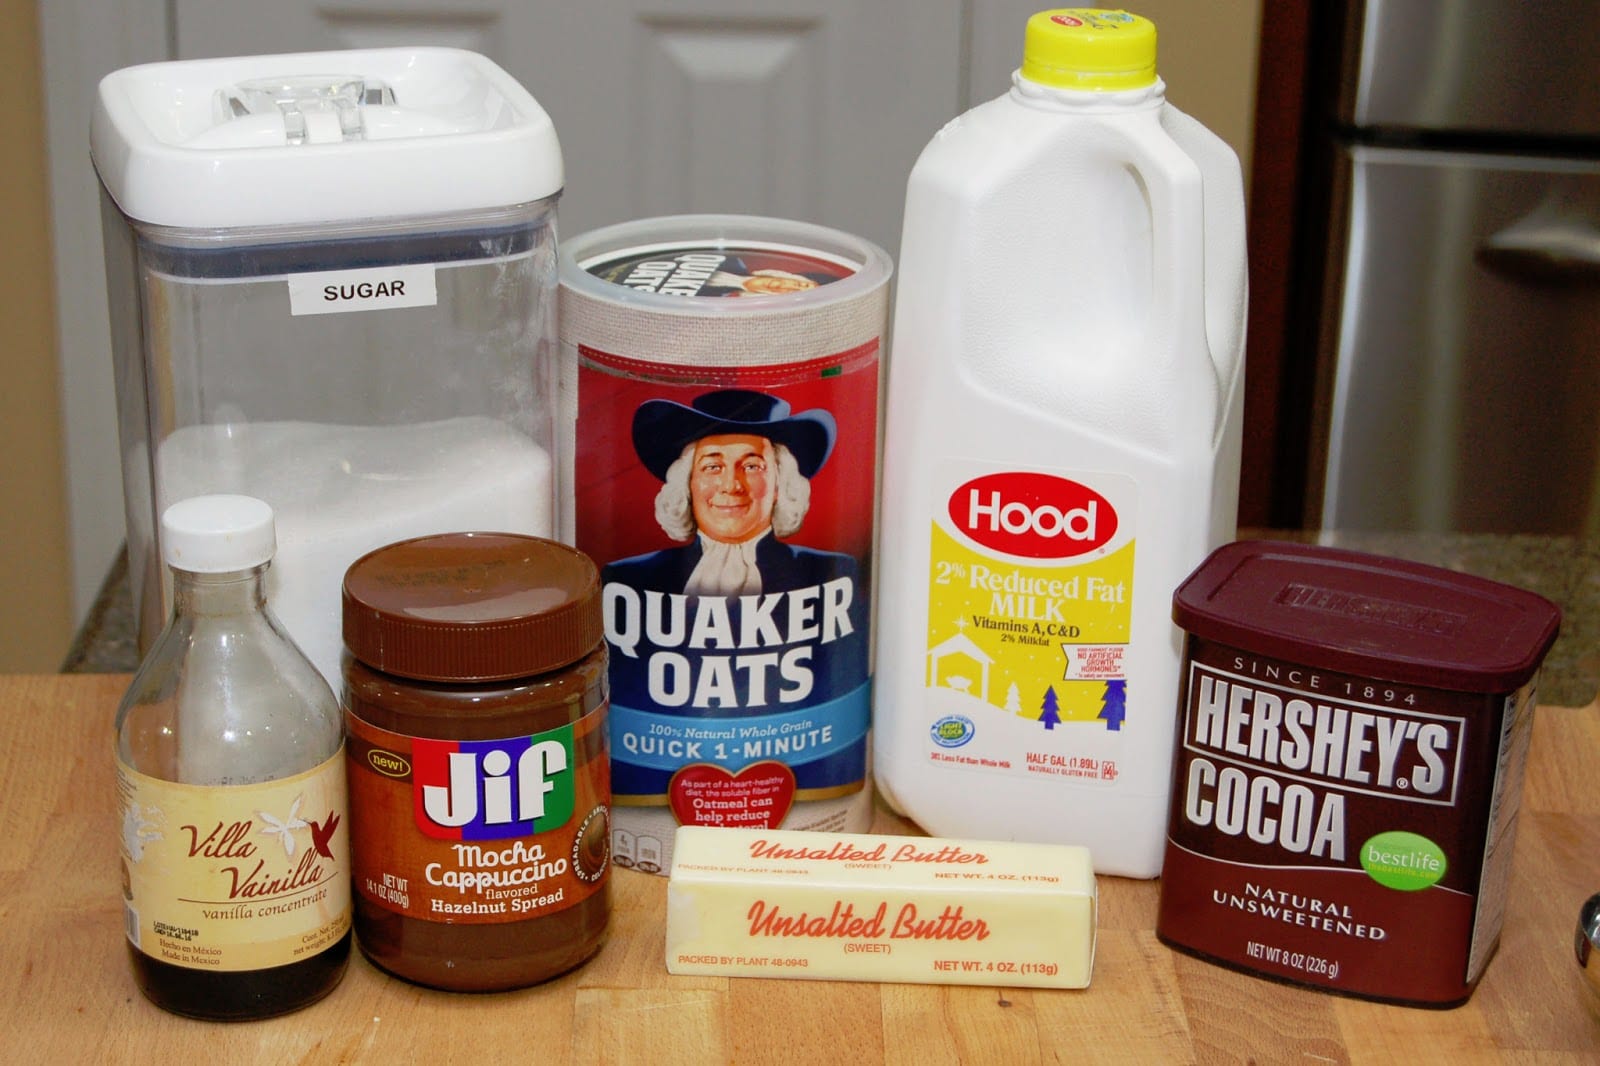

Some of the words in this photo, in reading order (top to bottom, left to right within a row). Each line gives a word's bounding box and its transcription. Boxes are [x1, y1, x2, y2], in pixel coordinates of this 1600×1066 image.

[323, 280, 405, 301] SUGAR
[968, 488, 1098, 541] Hood
[935, 560, 966, 585] 2%
[970, 565, 1080, 599] Reduced
[1086, 577, 1126, 604] Fat
[602, 576, 854, 658] QUAKER
[989, 593, 1066, 622] MILK
[972, 615, 1029, 635] Vitamins
[1000, 633, 1016, 643] 2%
[1017, 634, 1050, 647] Milkfat
[648, 646, 813, 708] OATS
[1233, 657, 1320, 689] SINCE
[1343, 682, 1416, 706] 1894
[649, 723, 683, 738] 100%
[684, 726, 736, 740] Natural
[739, 725, 778, 738] Whole
[780, 719, 813, 735] Grain
[1195, 675, 1448, 795] HERSHEY'S
[622, 733, 702, 760] QUICK
[714, 725, 833, 760] 1-MINUTE
[373, 754, 403, 772] new!
[1026, 752, 1048, 764] HALF
[1050, 754, 1067, 766] GAL
[1070, 757, 1098, 770] (1.89L)
[1028, 765, 1060, 775] NATURALLY
[1061, 768, 1082, 777] GLUTEN
[422, 740, 567, 827] Jif
[680, 779, 692, 788] As
[694, 780, 712, 789] part
[712, 780, 722, 788] of
[730, 776, 784, 788] heart-healthy
[685, 789, 704, 798] diet,
[706, 789, 720, 797] the
[722, 788, 750, 797] soluble
[752, 787, 770, 796] fiber
[692, 796, 748, 809] Oatmeal
[750, 797, 773, 807] can
[1185, 758, 1346, 862] COCOA
[695, 810, 724, 824] help
[726, 810, 770, 822] reduce
[180, 820, 258, 858] Villa
[451, 841, 546, 868] Mocha
[748, 839, 886, 862] Unsalted
[891, 842, 989, 866] Butter
[1368, 845, 1440, 871] bestlife
[220, 846, 324, 900] Vainilla
[424, 857, 568, 895] Cappuccino
[678, 864, 720, 872] PACKED
[844, 862, 892, 870] (SWEET)
[934, 872, 960, 880] NET
[962, 872, 984, 881] WT.
[996, 874, 1018, 882] OZ.
[1020, 874, 1060, 884] (113g)
[383, 872, 396, 888] NET
[396, 878, 408, 892] WT
[486, 884, 539, 900] flavored
[202, 904, 253, 920] vanilla
[258, 888, 328, 918] concentrate
[378, 886, 387, 900] OZ
[388, 888, 409, 909] (400g)
[431, 898, 506, 915] Hazelnut
[511, 890, 564, 913] Spread
[1245, 882, 1354, 920] NATURAL
[746, 900, 886, 940] Unsalted
[890, 902, 990, 942] Butter
[1212, 889, 1387, 941] UNSWEETENED
[160, 938, 181, 950] Hecho
[192, 945, 222, 956] México
[162, 948, 180, 960] Made
[182, 954, 190, 962] in
[192, 956, 220, 966] Mexico
[843, 942, 892, 954] (SWEET)
[1246, 940, 1264, 959] NET
[1264, 943, 1282, 963] WT
[1282, 949, 1290, 966] 8
[1290, 950, 1305, 970] OZ
[1305, 954, 1328, 976] (226
[1328, 960, 1340, 978] g)
[678, 954, 718, 966] PACKED
[720, 956, 734, 966] BY
[736, 956, 769, 968] PLANT
[770, 958, 809, 968] 48-0943
[934, 960, 959, 972] NET
[960, 961, 984, 972] WT.
[986, 962, 994, 972] 4
[996, 962, 1018, 974] OZ.
[1020, 962, 1058, 976] (113g)
